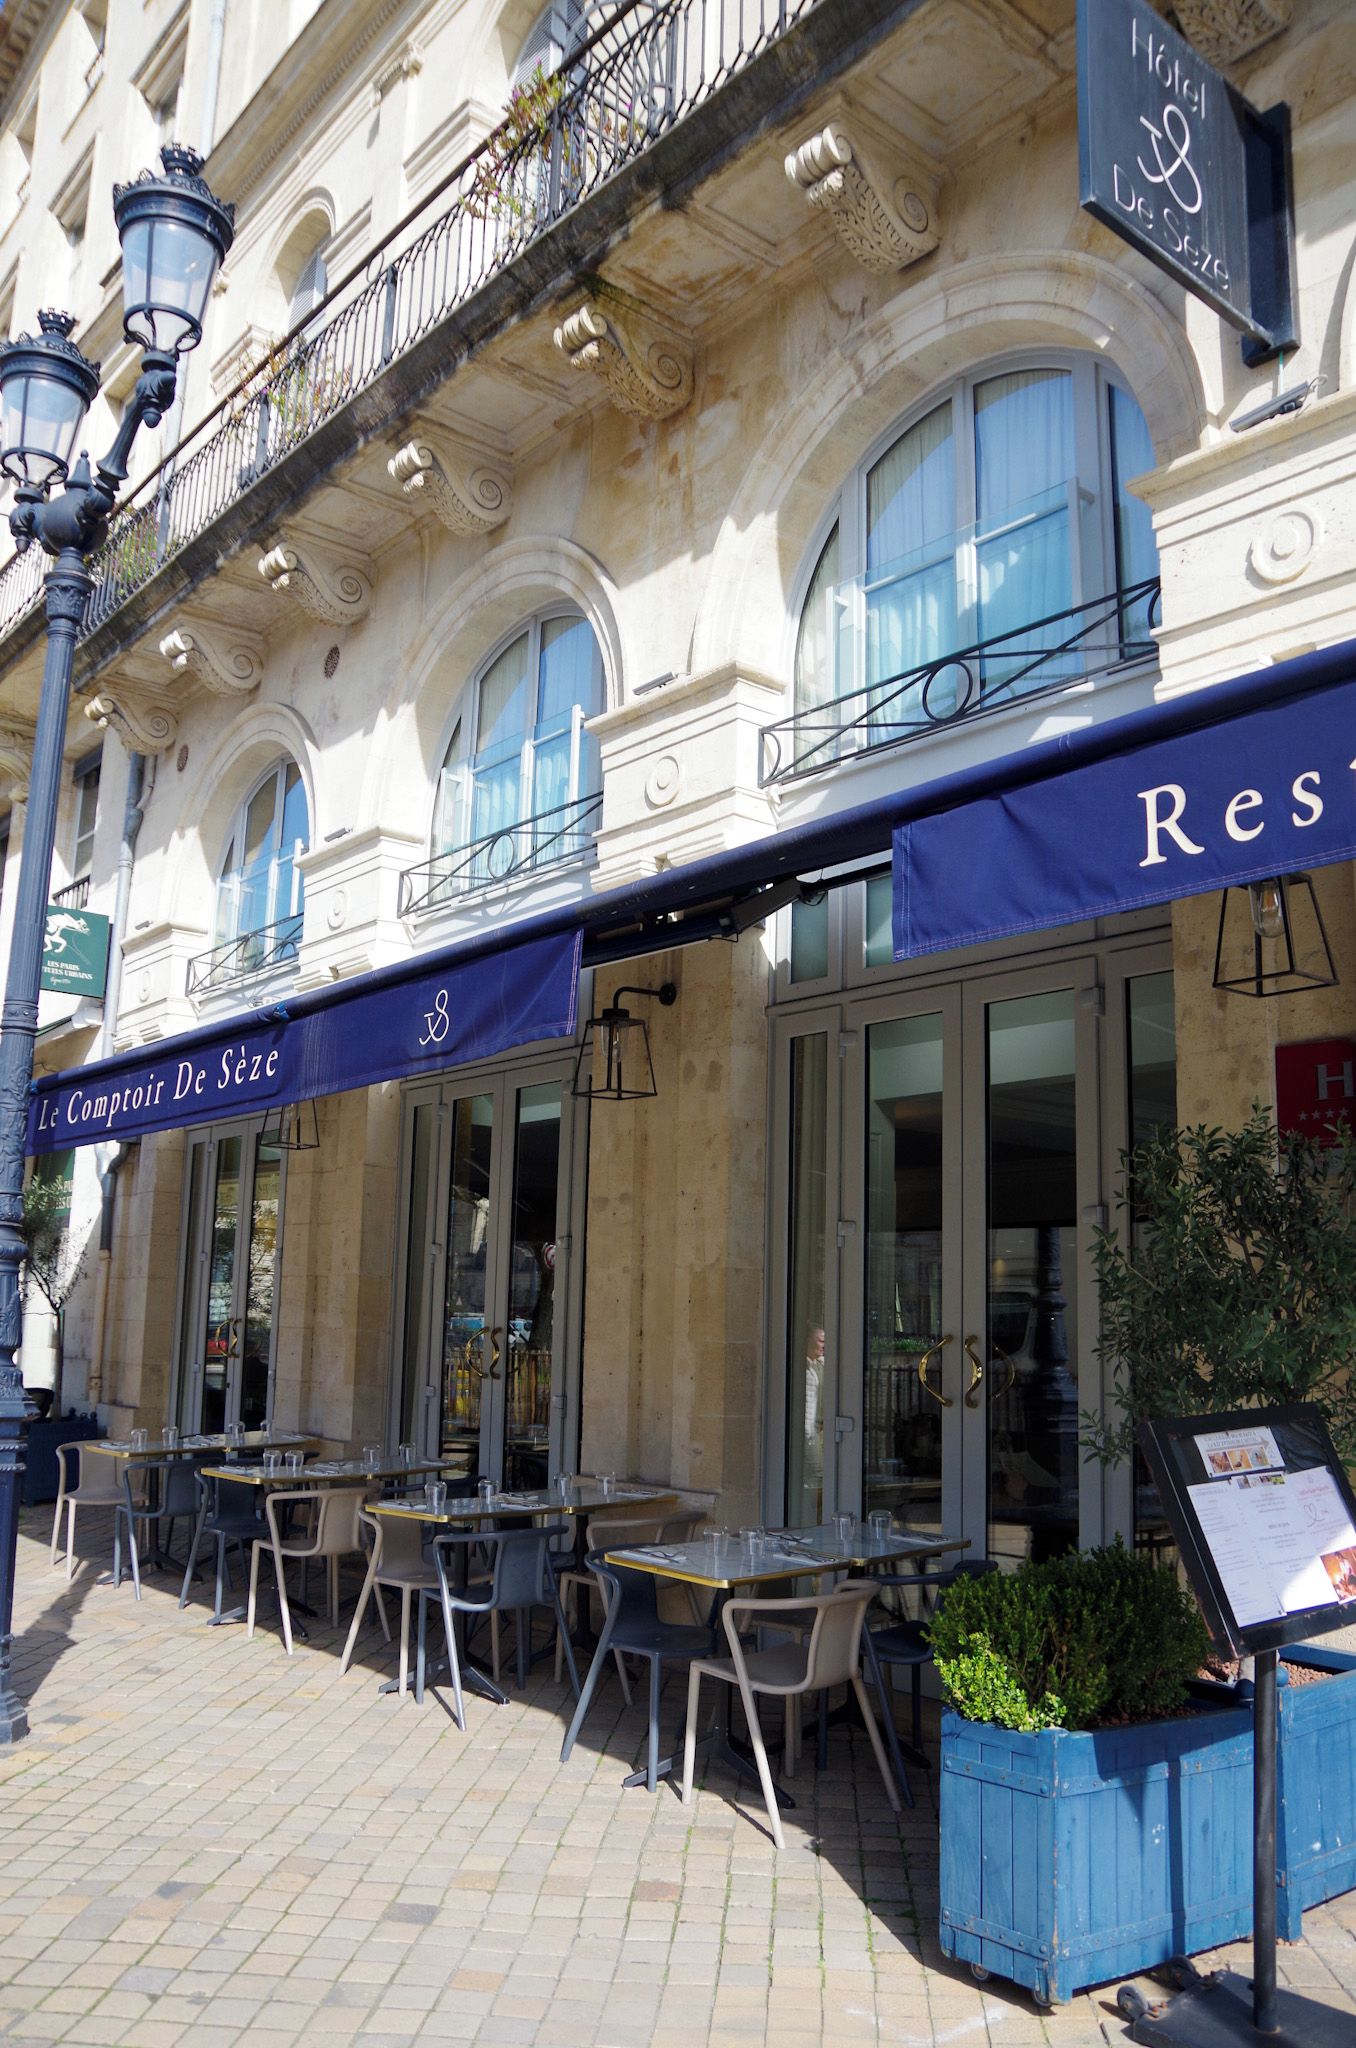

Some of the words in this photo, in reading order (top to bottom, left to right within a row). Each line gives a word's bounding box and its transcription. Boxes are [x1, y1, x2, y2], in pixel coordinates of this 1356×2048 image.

[1113, 163, 1154, 230] De
[1136, 758, 1356, 868] Res
[37, 1099, 59, 1131] Le
[66, 1073, 165, 1128] Comptoir
[173, 1061, 206, 1100] De
[217, 1044, 279, 1089] Sèze
[1315, 1060, 1356, 1101] H
